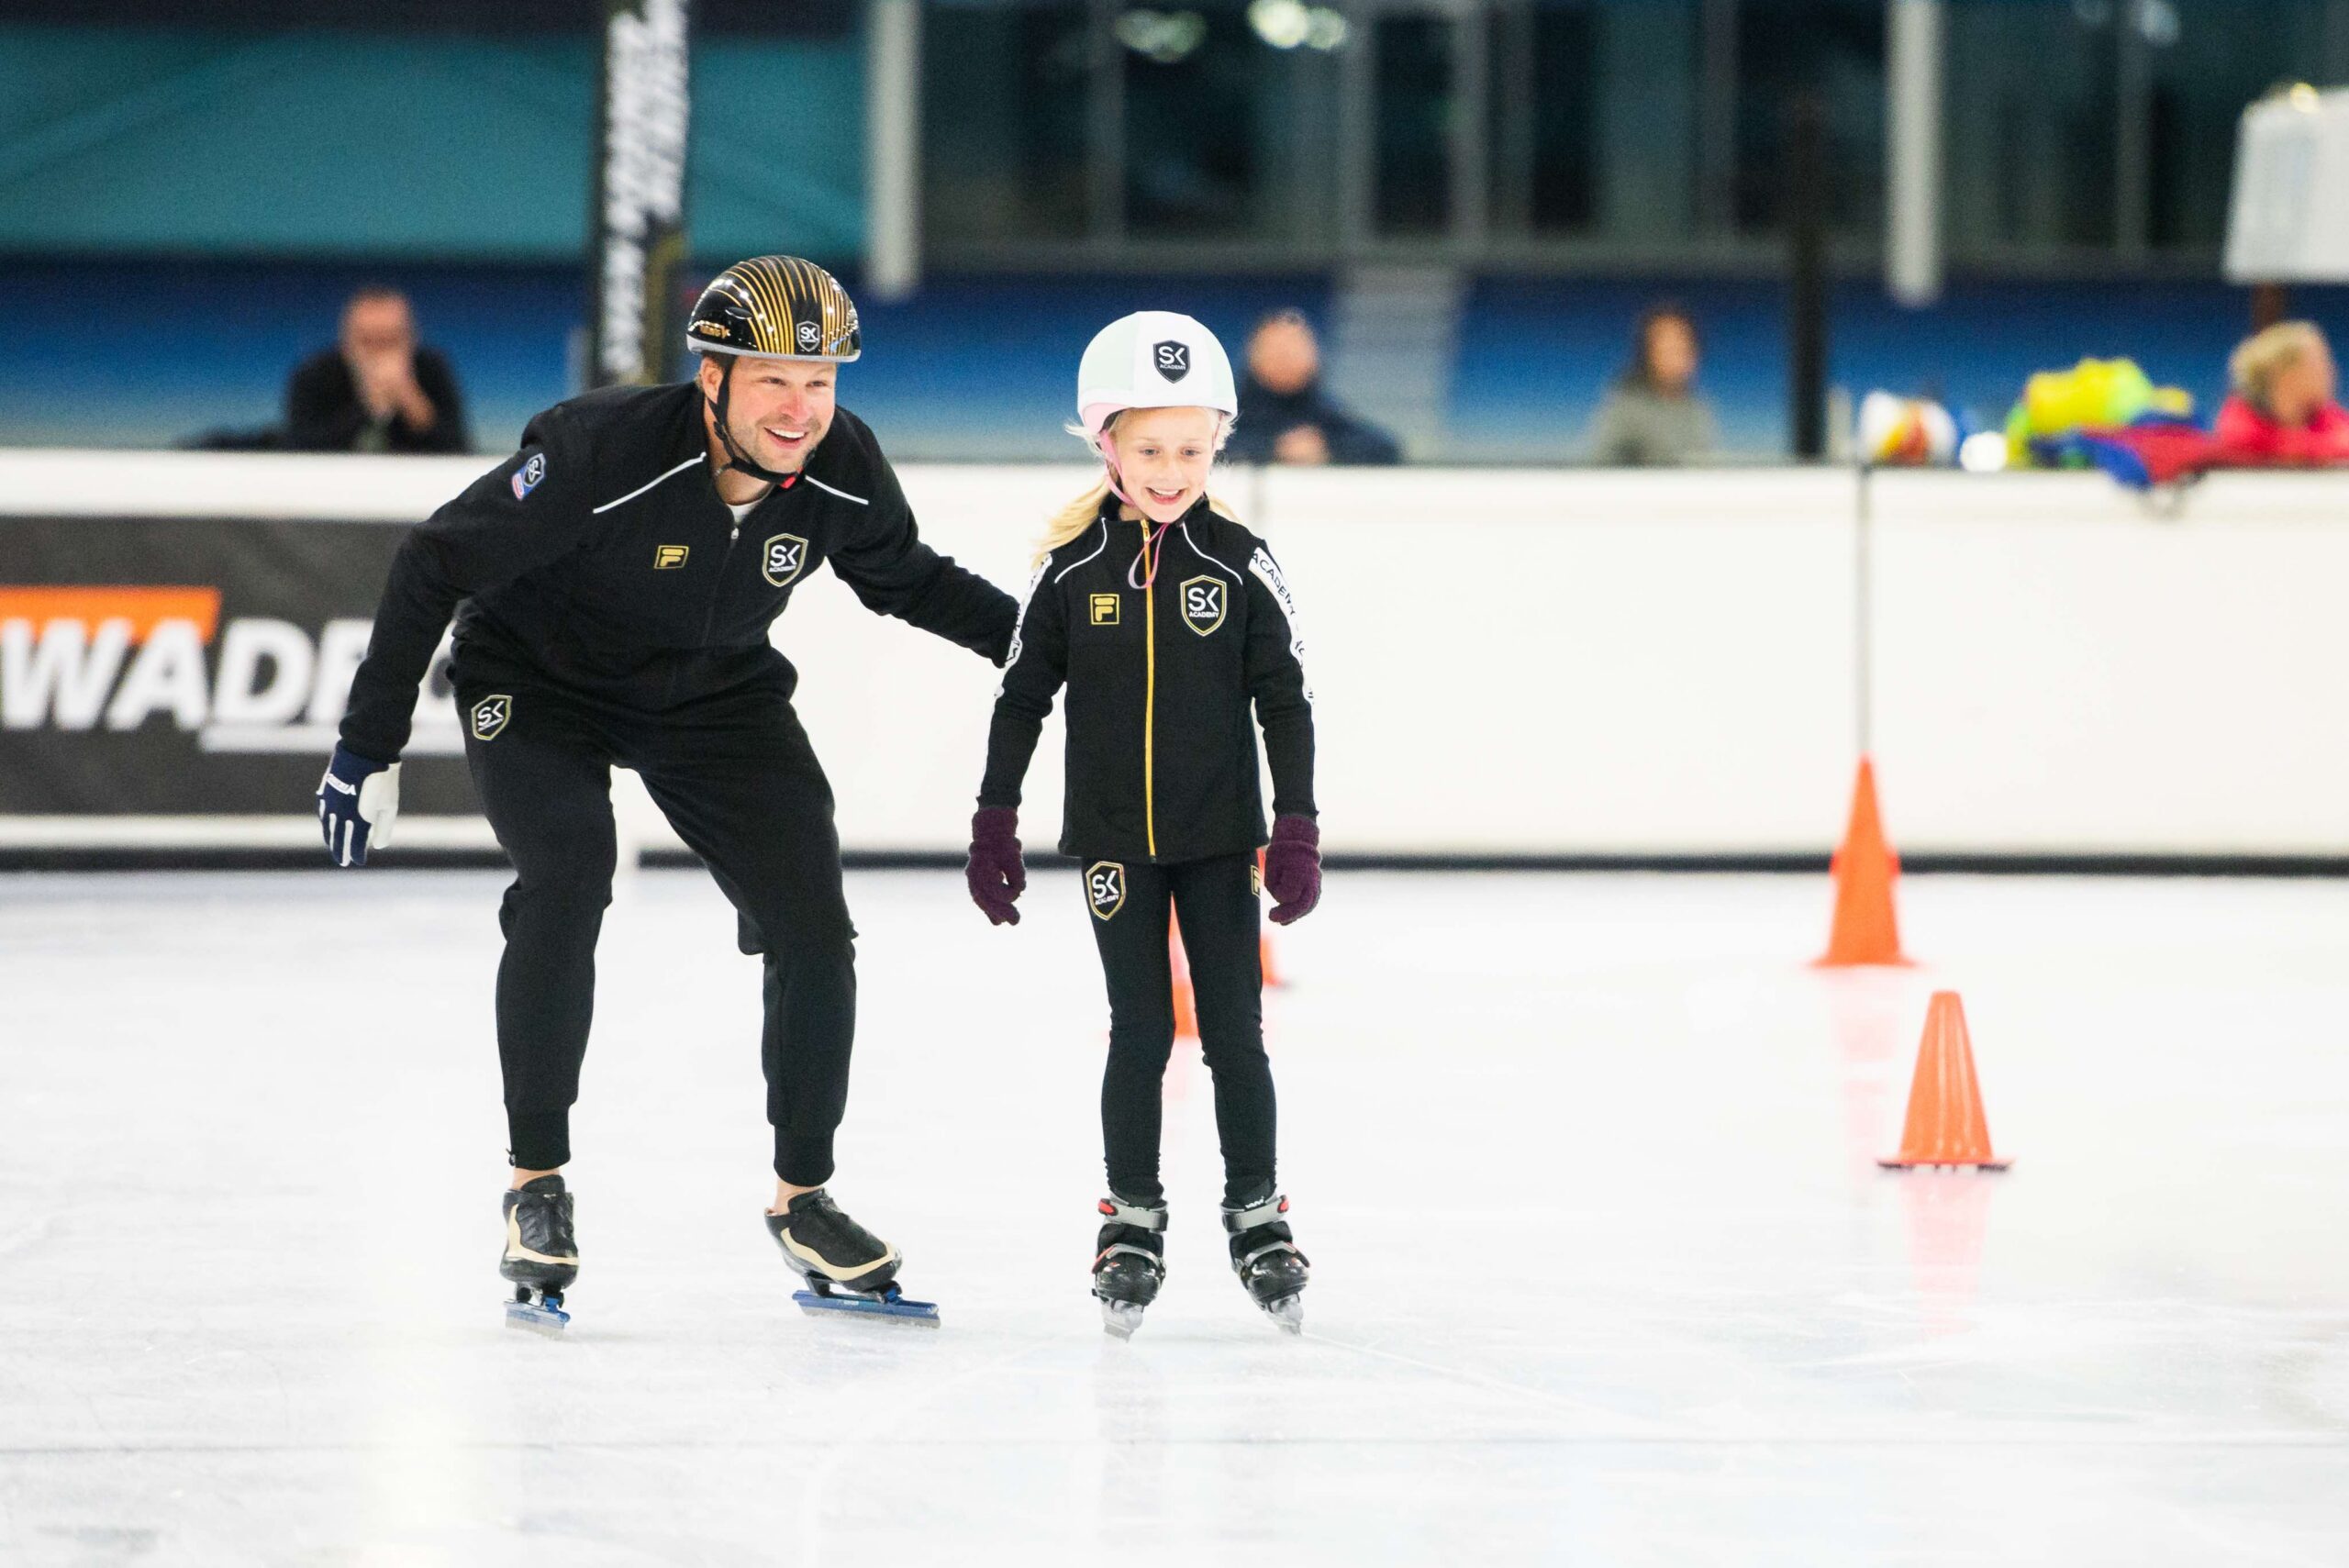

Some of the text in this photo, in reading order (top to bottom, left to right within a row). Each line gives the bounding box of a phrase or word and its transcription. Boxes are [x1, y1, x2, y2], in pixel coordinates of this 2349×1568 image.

[800, 326, 819, 340] SK
[1158, 345, 1186, 366] SK
[770, 544, 801, 567] SK
[1187, 586, 1219, 612] SK
[477, 700, 505, 727] SK
[1092, 870, 1119, 899] SK
